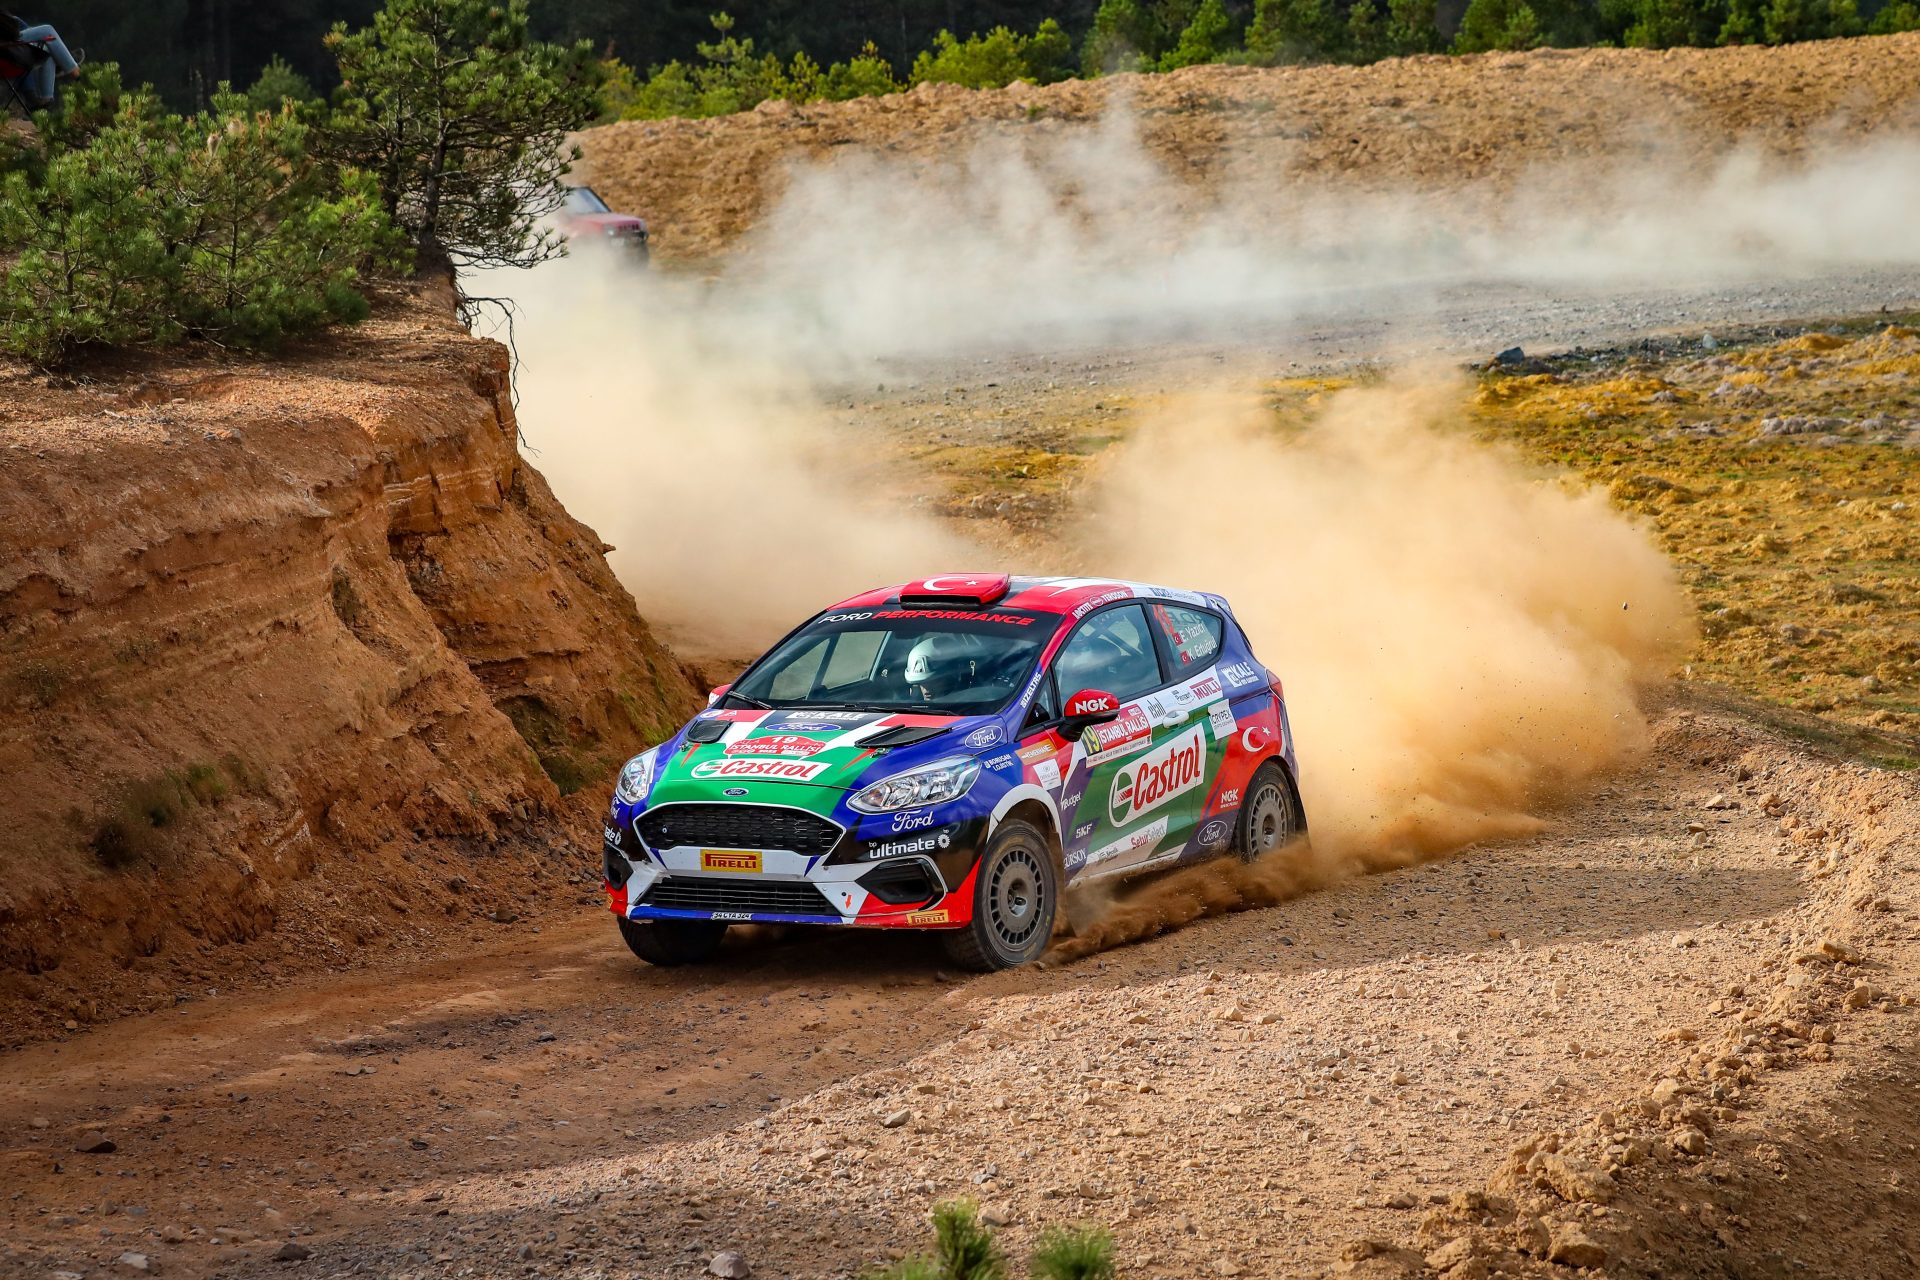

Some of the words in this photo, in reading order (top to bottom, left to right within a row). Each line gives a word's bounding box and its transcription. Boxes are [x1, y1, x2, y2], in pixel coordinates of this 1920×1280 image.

[818, 612, 873, 624] FORD
[872, 610, 1037, 626] PERFORMANCE
[1075, 697, 1109, 714] NGK
[772, 736, 799, 744] 19
[972, 729, 997, 746] Ford
[720, 760, 818, 778] Castrol
[1134, 734, 1201, 811] Castrol
[1221, 788, 1239, 804] NGK
[891, 809, 935, 832] Ford
[1075, 823, 1093, 839] SKF
[1203, 823, 1221, 842] Ford
[868, 841, 878, 850] bp
[869, 838, 935, 859] ultimate
[705, 853, 757, 869] PIRELLI
[911, 912, 946, 925] PIRELLI
